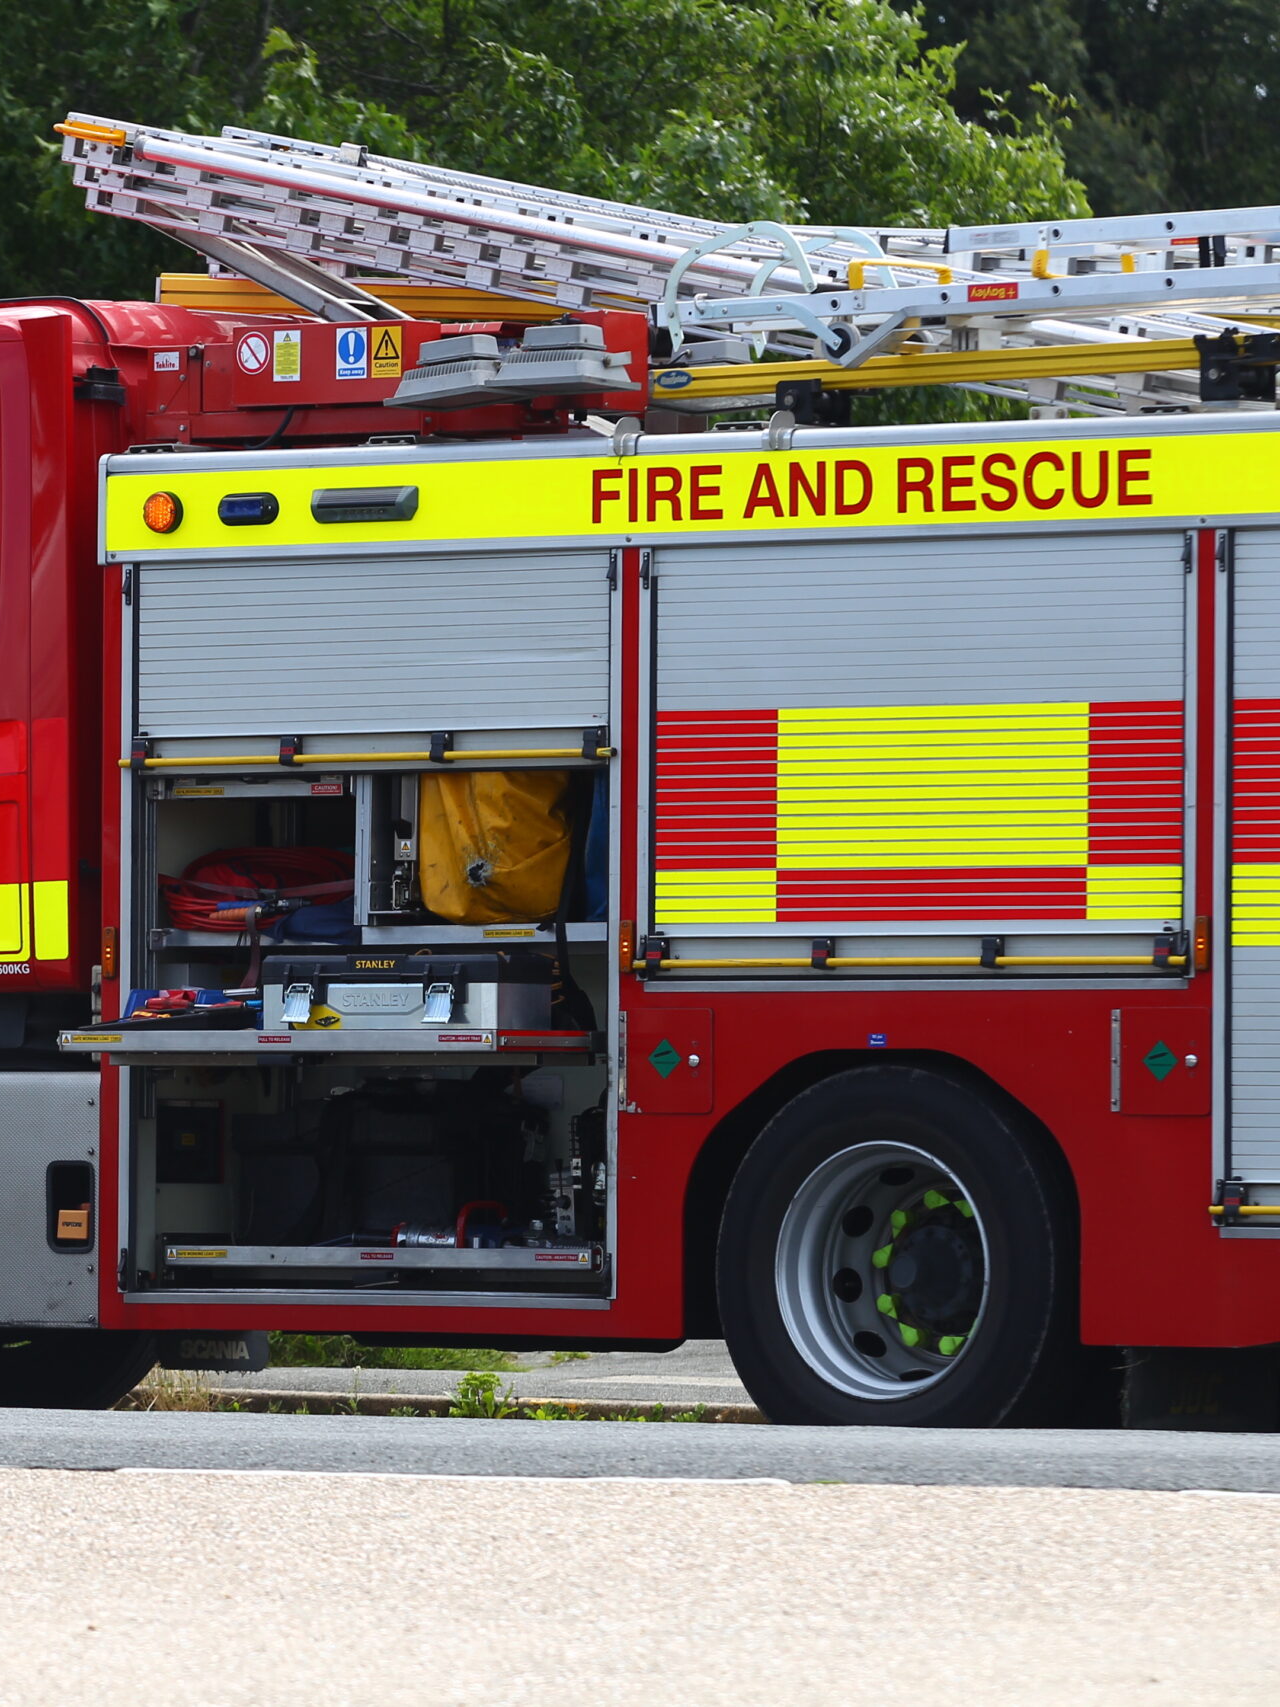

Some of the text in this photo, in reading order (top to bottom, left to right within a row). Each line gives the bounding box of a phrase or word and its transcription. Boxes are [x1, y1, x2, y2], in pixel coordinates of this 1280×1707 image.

[592, 450, 1153, 524] FIRE AND RESCUE
[355, 959, 396, 969] STANLEY
[342, 992, 409, 1007] STANLEY
[181, 1340, 250, 1360] SCANIA
